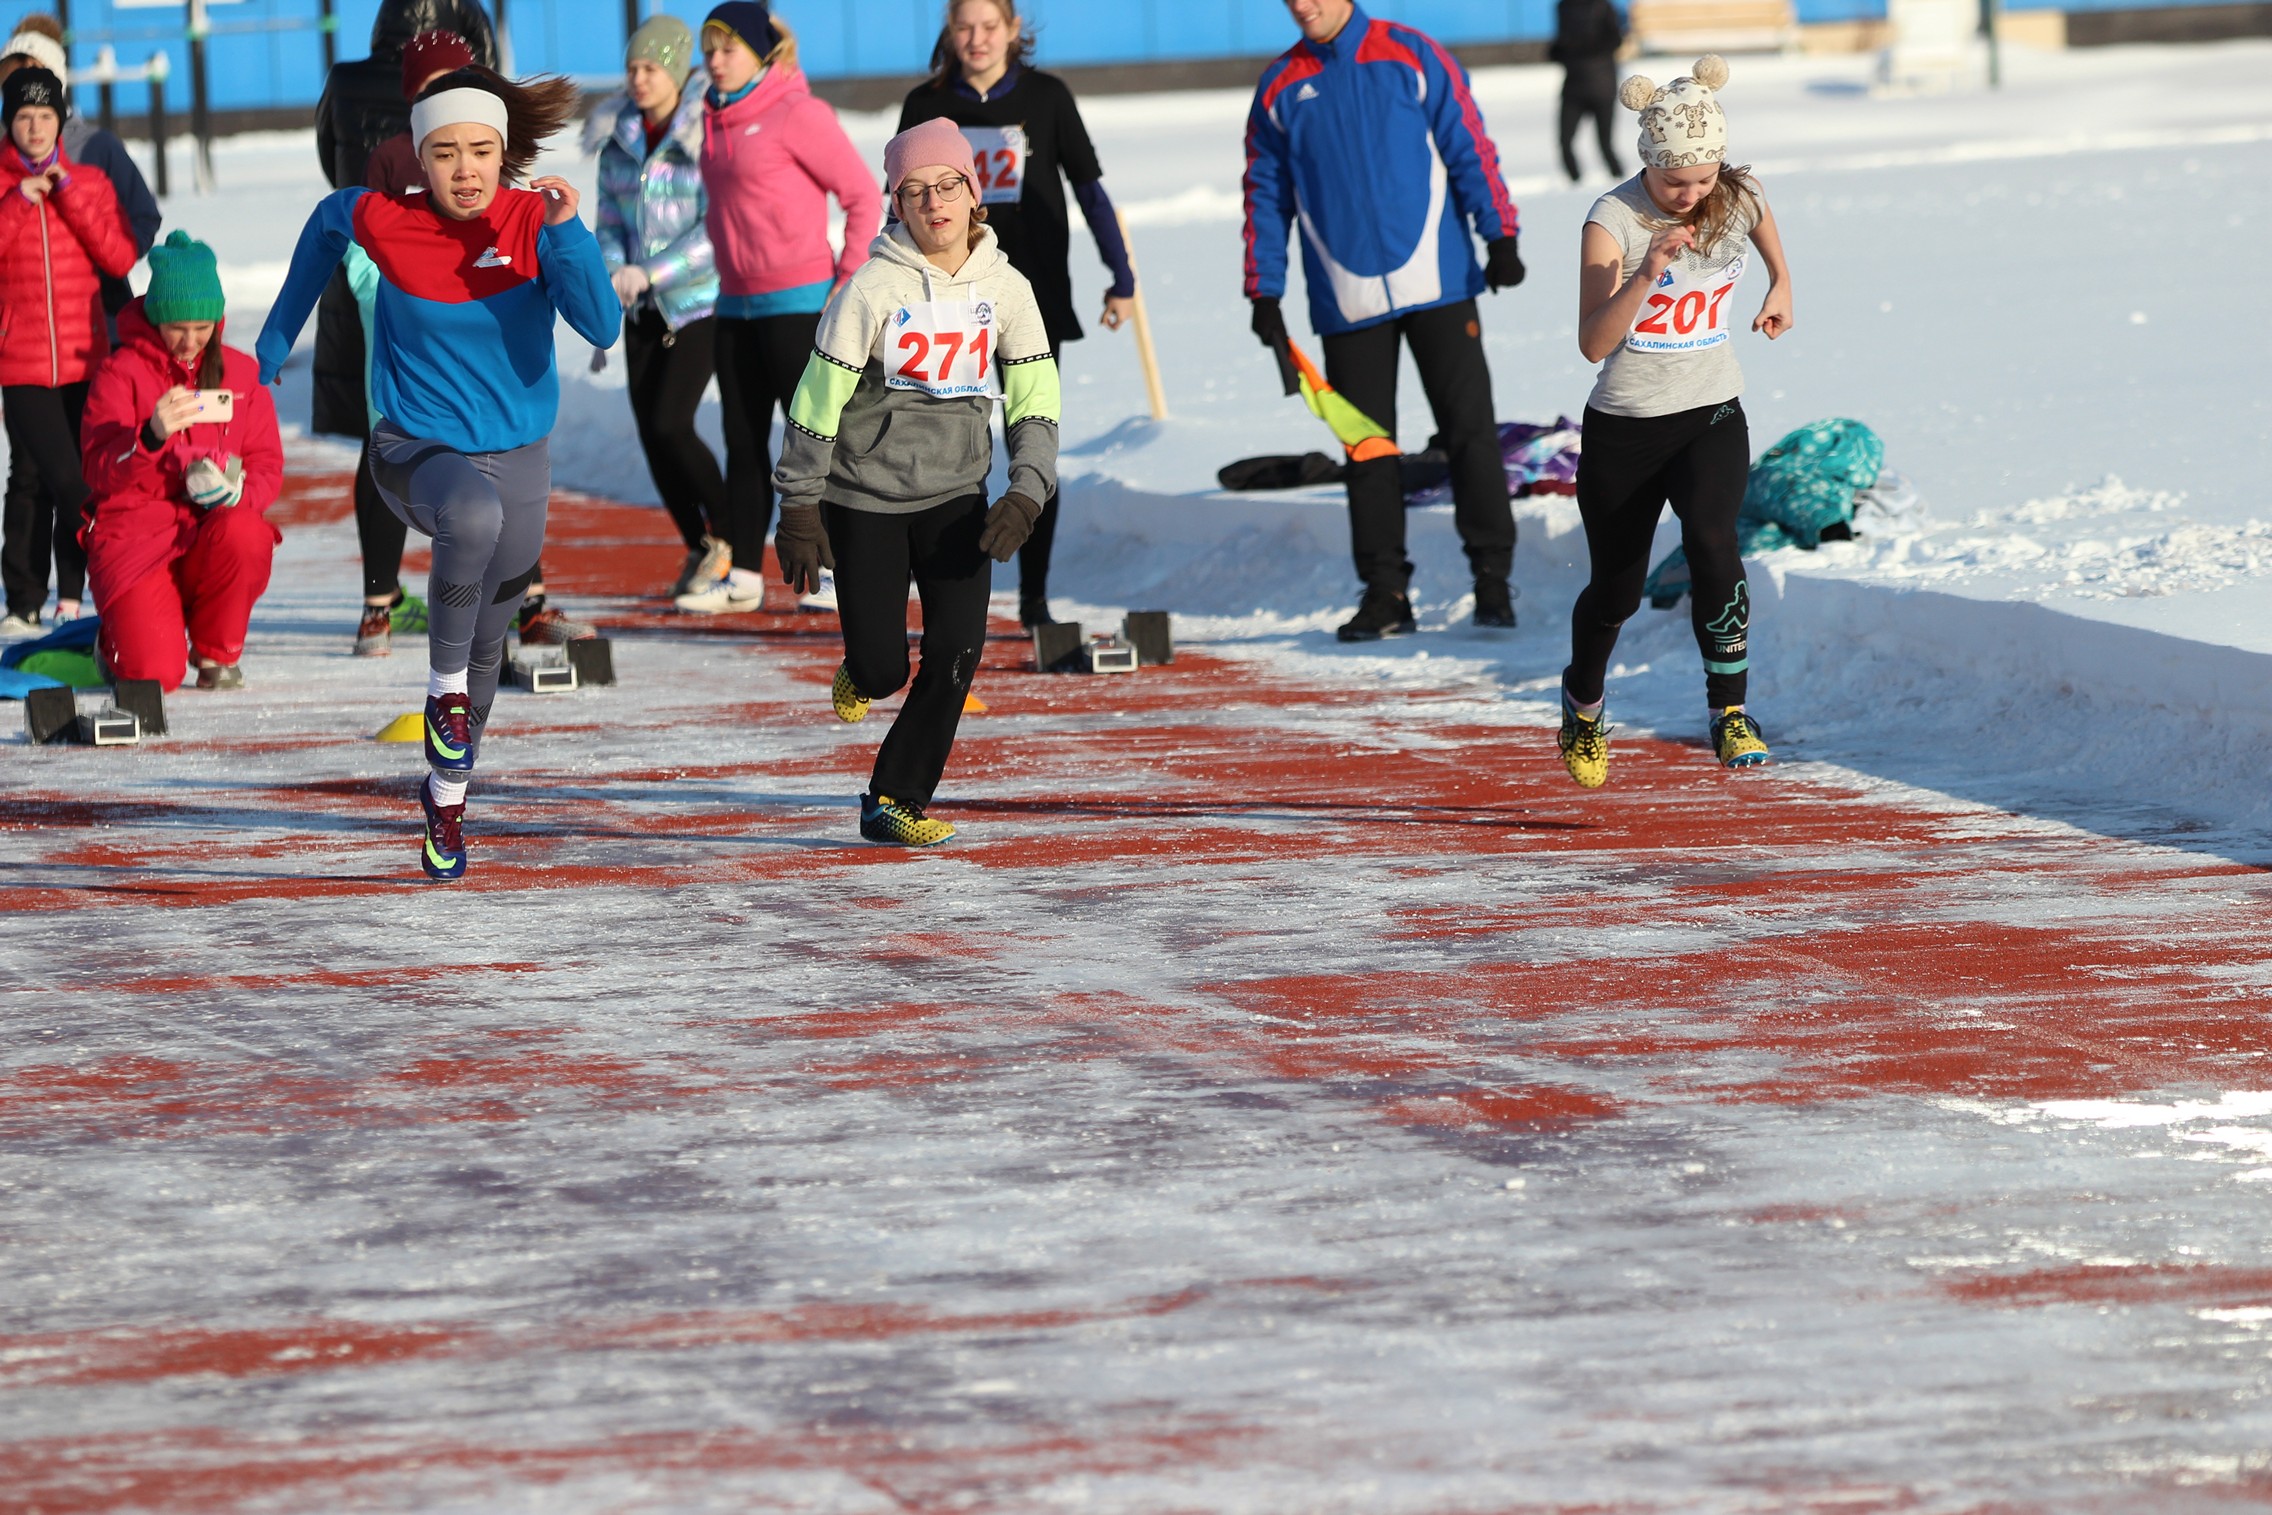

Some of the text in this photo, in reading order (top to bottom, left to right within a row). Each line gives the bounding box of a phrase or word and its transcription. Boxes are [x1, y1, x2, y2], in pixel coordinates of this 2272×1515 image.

[1635, 282, 1734, 334] 207
[897, 328, 988, 382] 271
[1629, 333, 1727, 349] САХАЛИНСКАЯ ОБЛАСТЬ
[1715, 640, 1747, 653] UNITED
